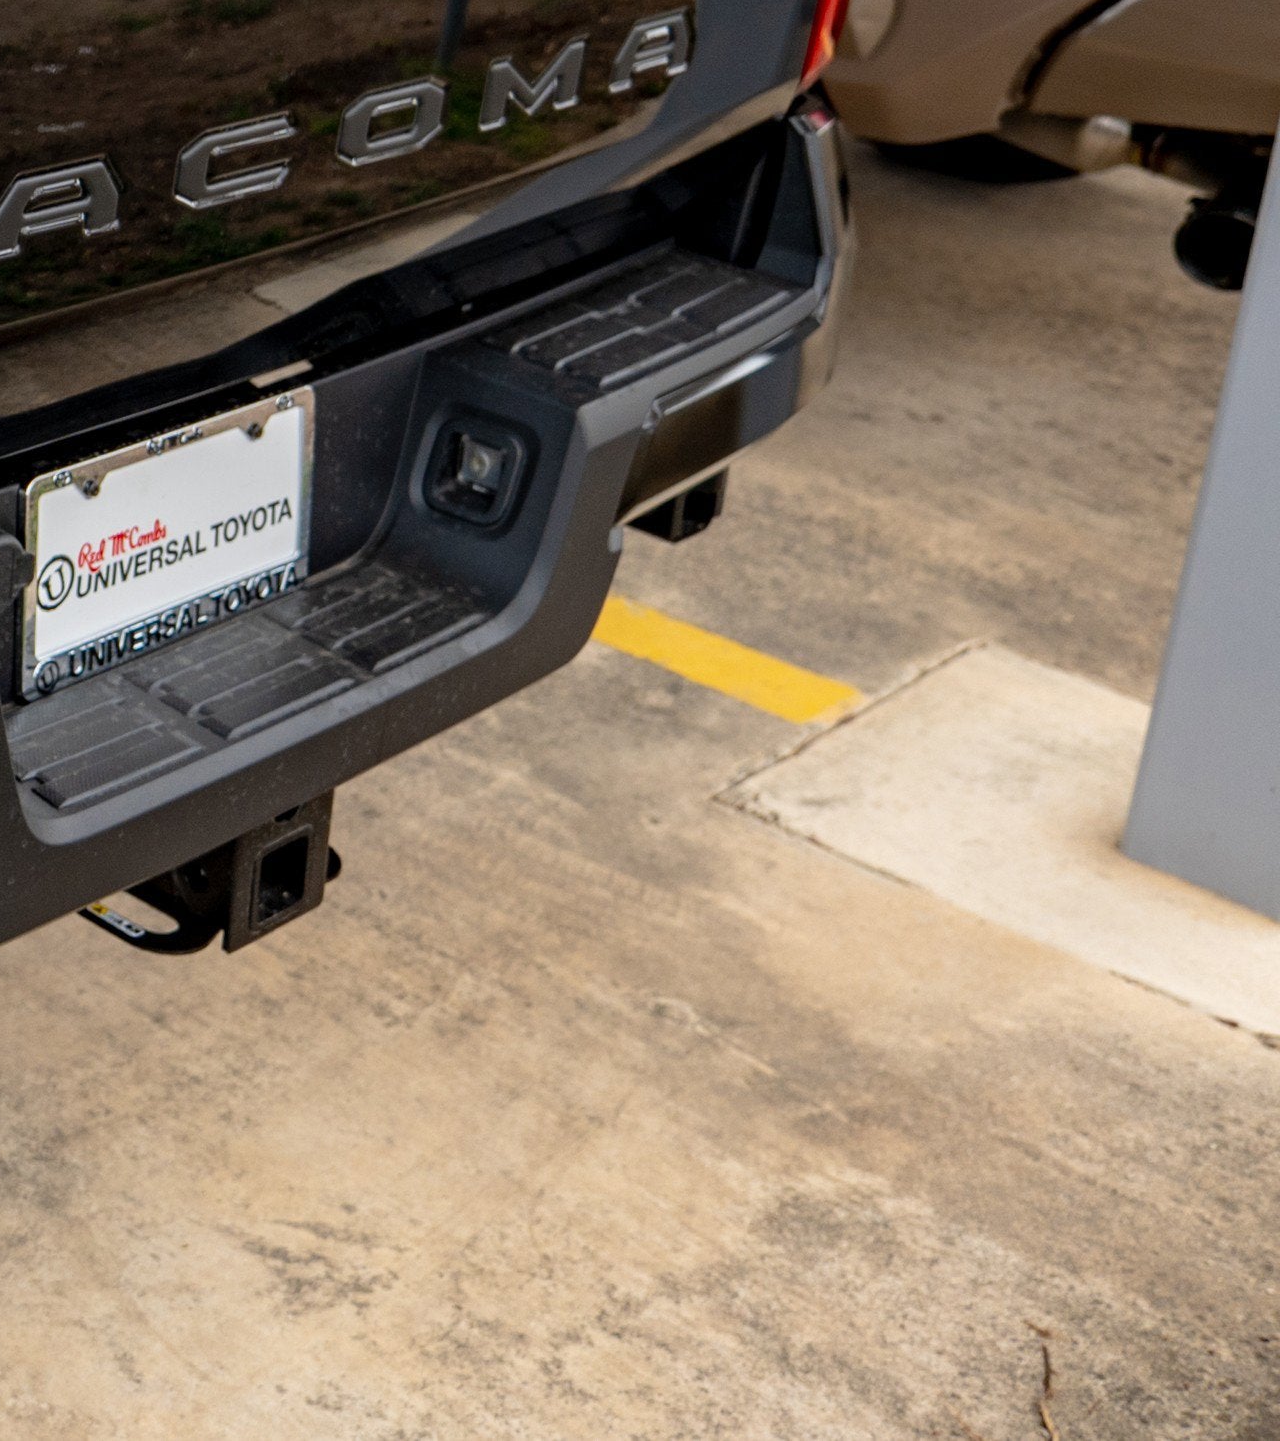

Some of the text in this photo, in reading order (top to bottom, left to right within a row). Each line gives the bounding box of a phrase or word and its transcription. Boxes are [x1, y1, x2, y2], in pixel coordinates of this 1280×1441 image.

[76, 531, 207, 599] UNIVERSAL
[210, 497, 293, 548] TOYOTA
[78, 538, 105, 573] Red
[69, 600, 208, 677] UNIVERSAL
[208, 563, 300, 614] TOYOTA
